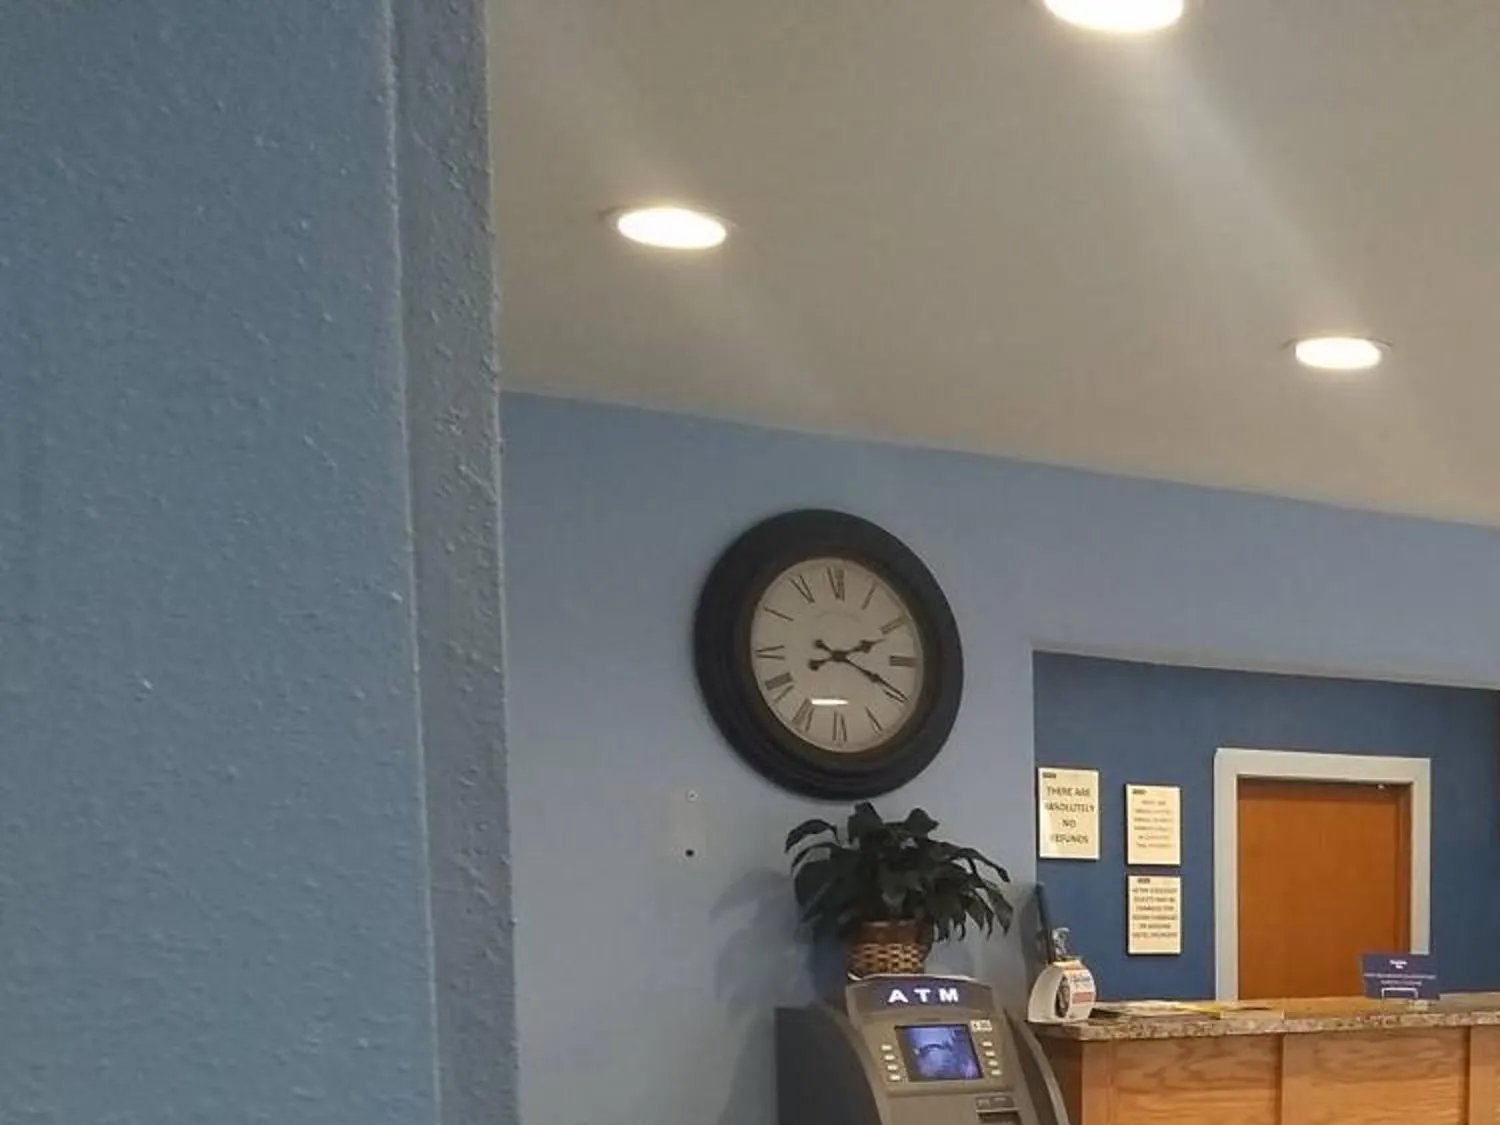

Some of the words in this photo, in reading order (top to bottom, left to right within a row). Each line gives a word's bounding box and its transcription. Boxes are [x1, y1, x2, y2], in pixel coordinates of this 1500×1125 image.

[1047, 786, 1073, 797] THERE
[1061, 819, 1077, 829] NO
[888, 987, 960, 1003] ATM
